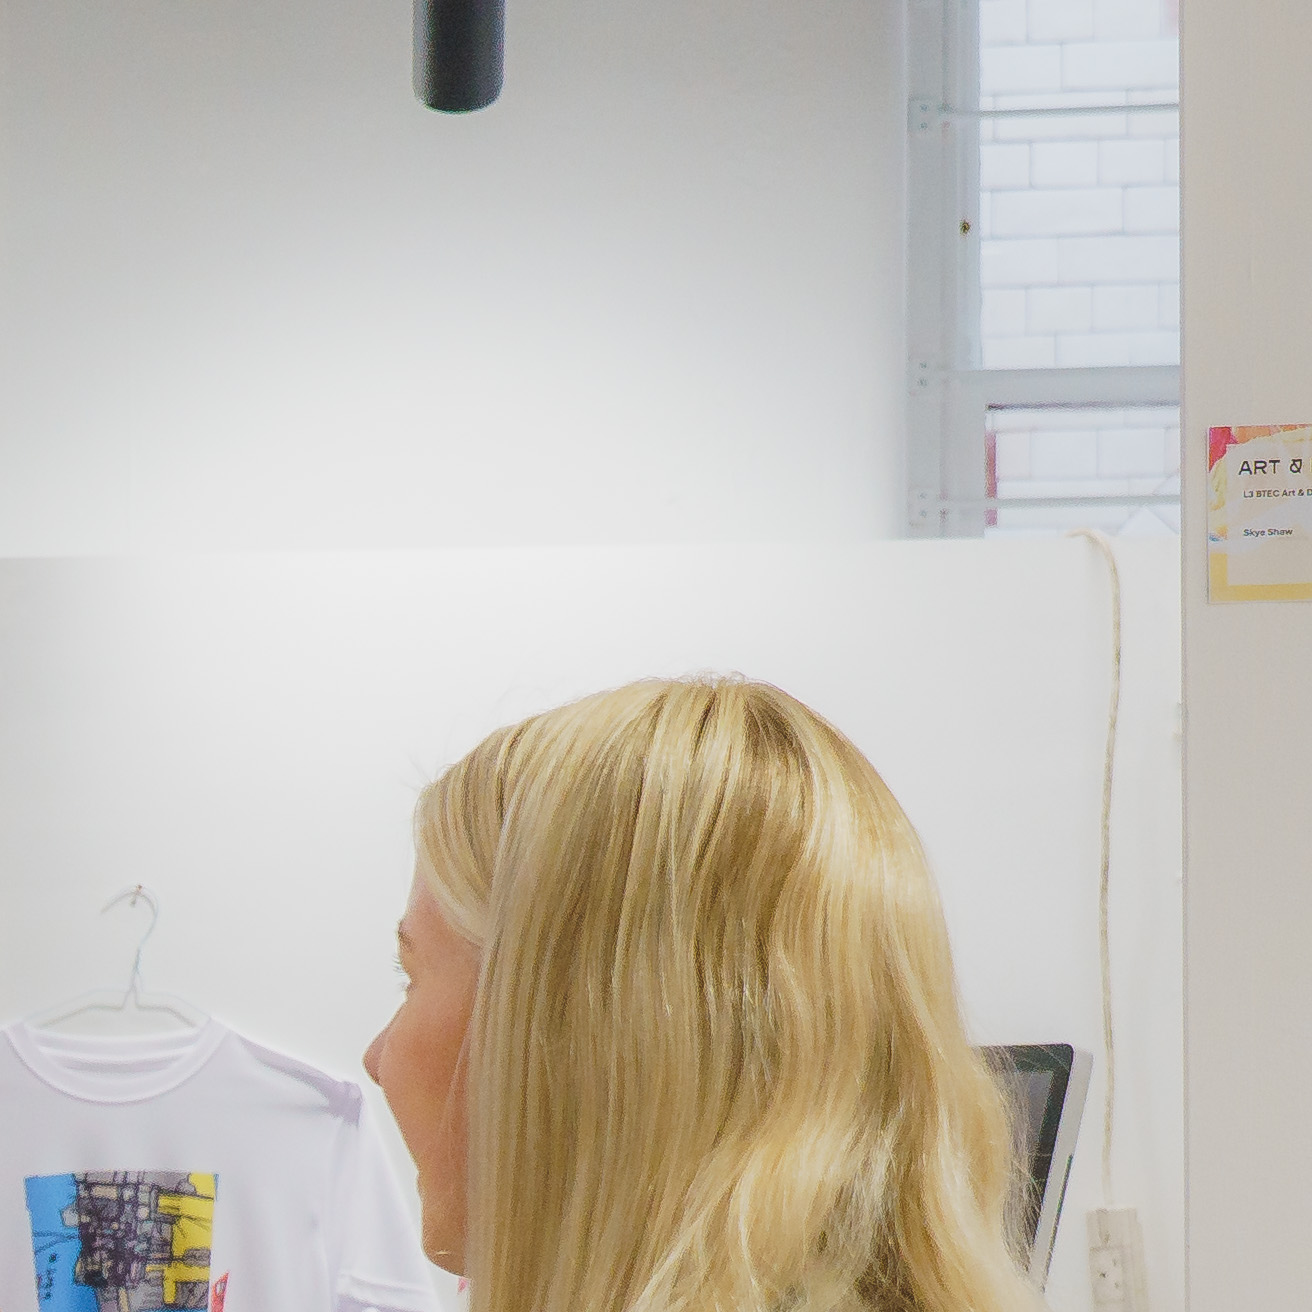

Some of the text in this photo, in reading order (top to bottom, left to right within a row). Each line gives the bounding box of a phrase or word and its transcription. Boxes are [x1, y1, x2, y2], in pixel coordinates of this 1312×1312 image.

[1238, 459, 1303, 475] ART &
[1243, 490, 1254, 498] L3
[1256, 489, 1280, 498] BTEC
[1281, 489, 1296, 497] Art
[1297, 488, 1305, 497] &
[1243, 528, 1294, 538] Skye Shaw
